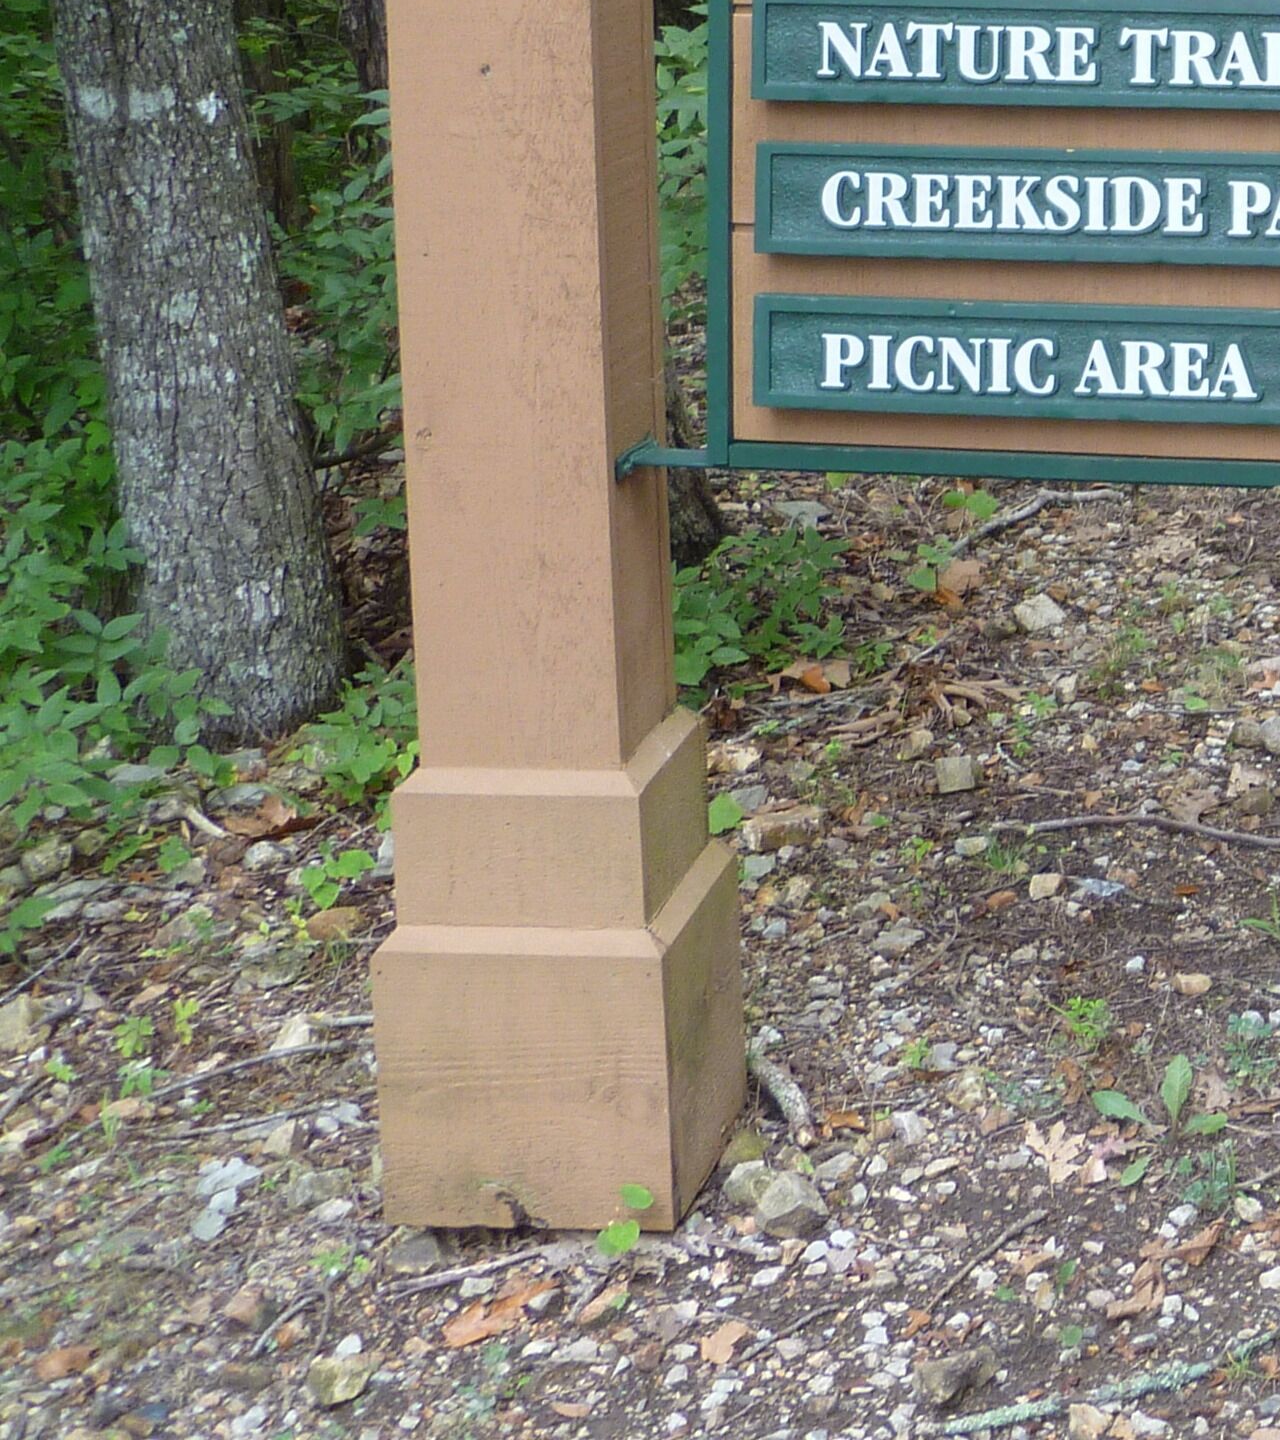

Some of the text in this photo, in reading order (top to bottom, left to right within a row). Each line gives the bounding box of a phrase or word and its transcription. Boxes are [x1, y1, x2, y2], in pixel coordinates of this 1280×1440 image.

[816, 20, 1097, 83] NATURE
[820, 170, 1204, 234] CREEKSIDE
[819, 332, 1259, 399] PICNIC AREA
